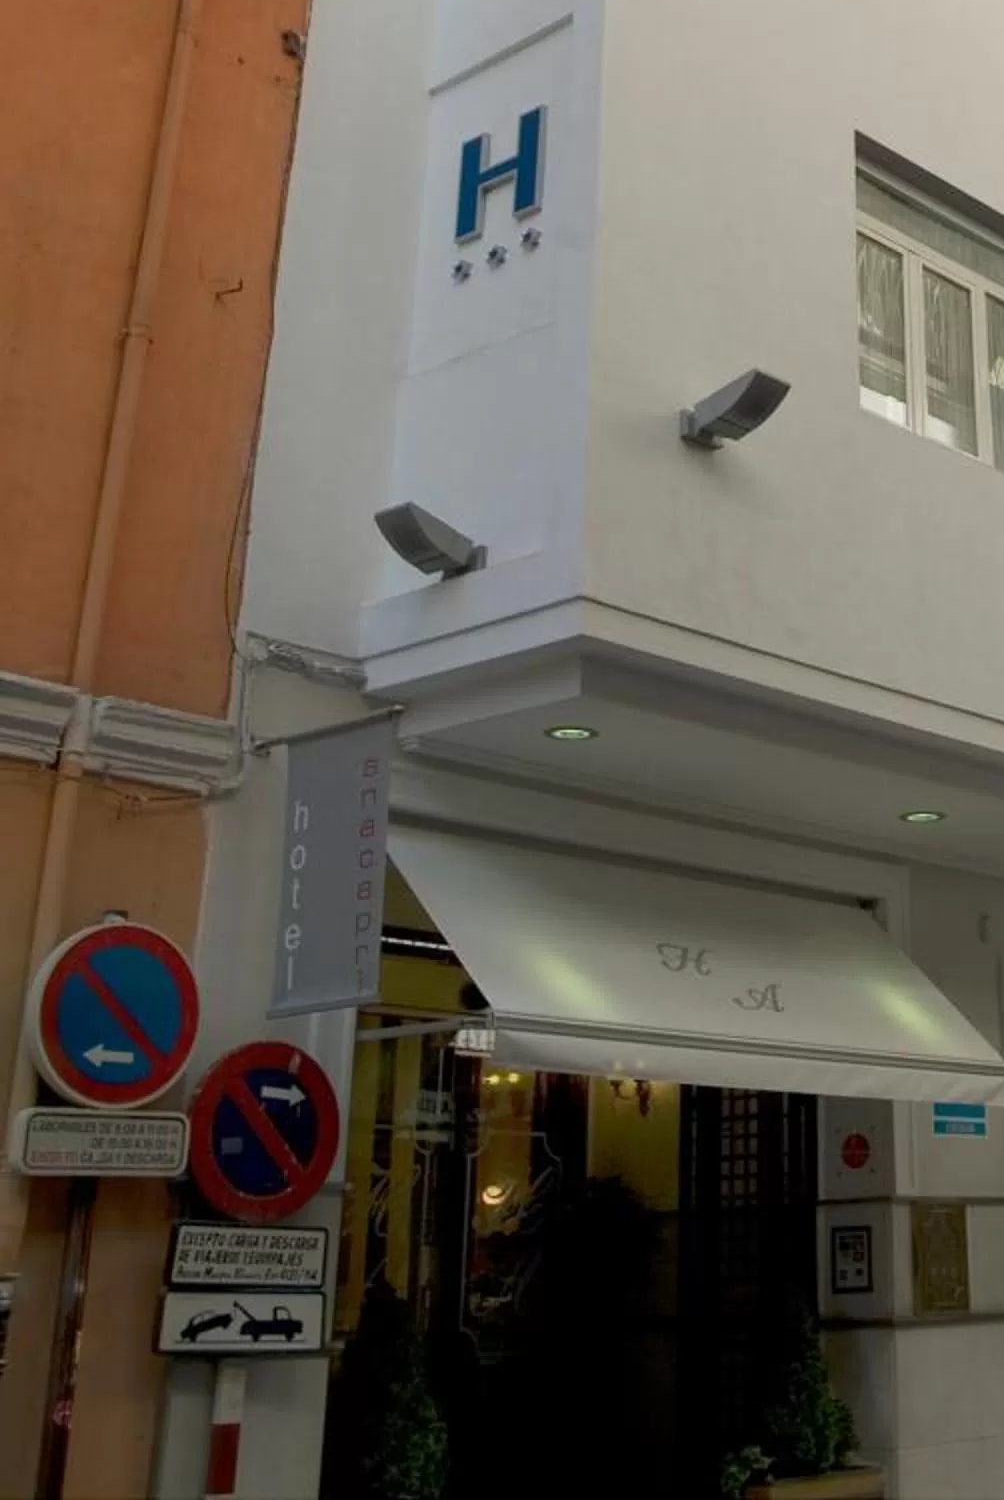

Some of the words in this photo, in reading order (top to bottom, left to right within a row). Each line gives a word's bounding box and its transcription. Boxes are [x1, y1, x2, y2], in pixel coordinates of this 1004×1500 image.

[454, 105, 546, 243] H
[284, 801, 309, 991] hotel
[355, 758, 379, 993] anacapri
